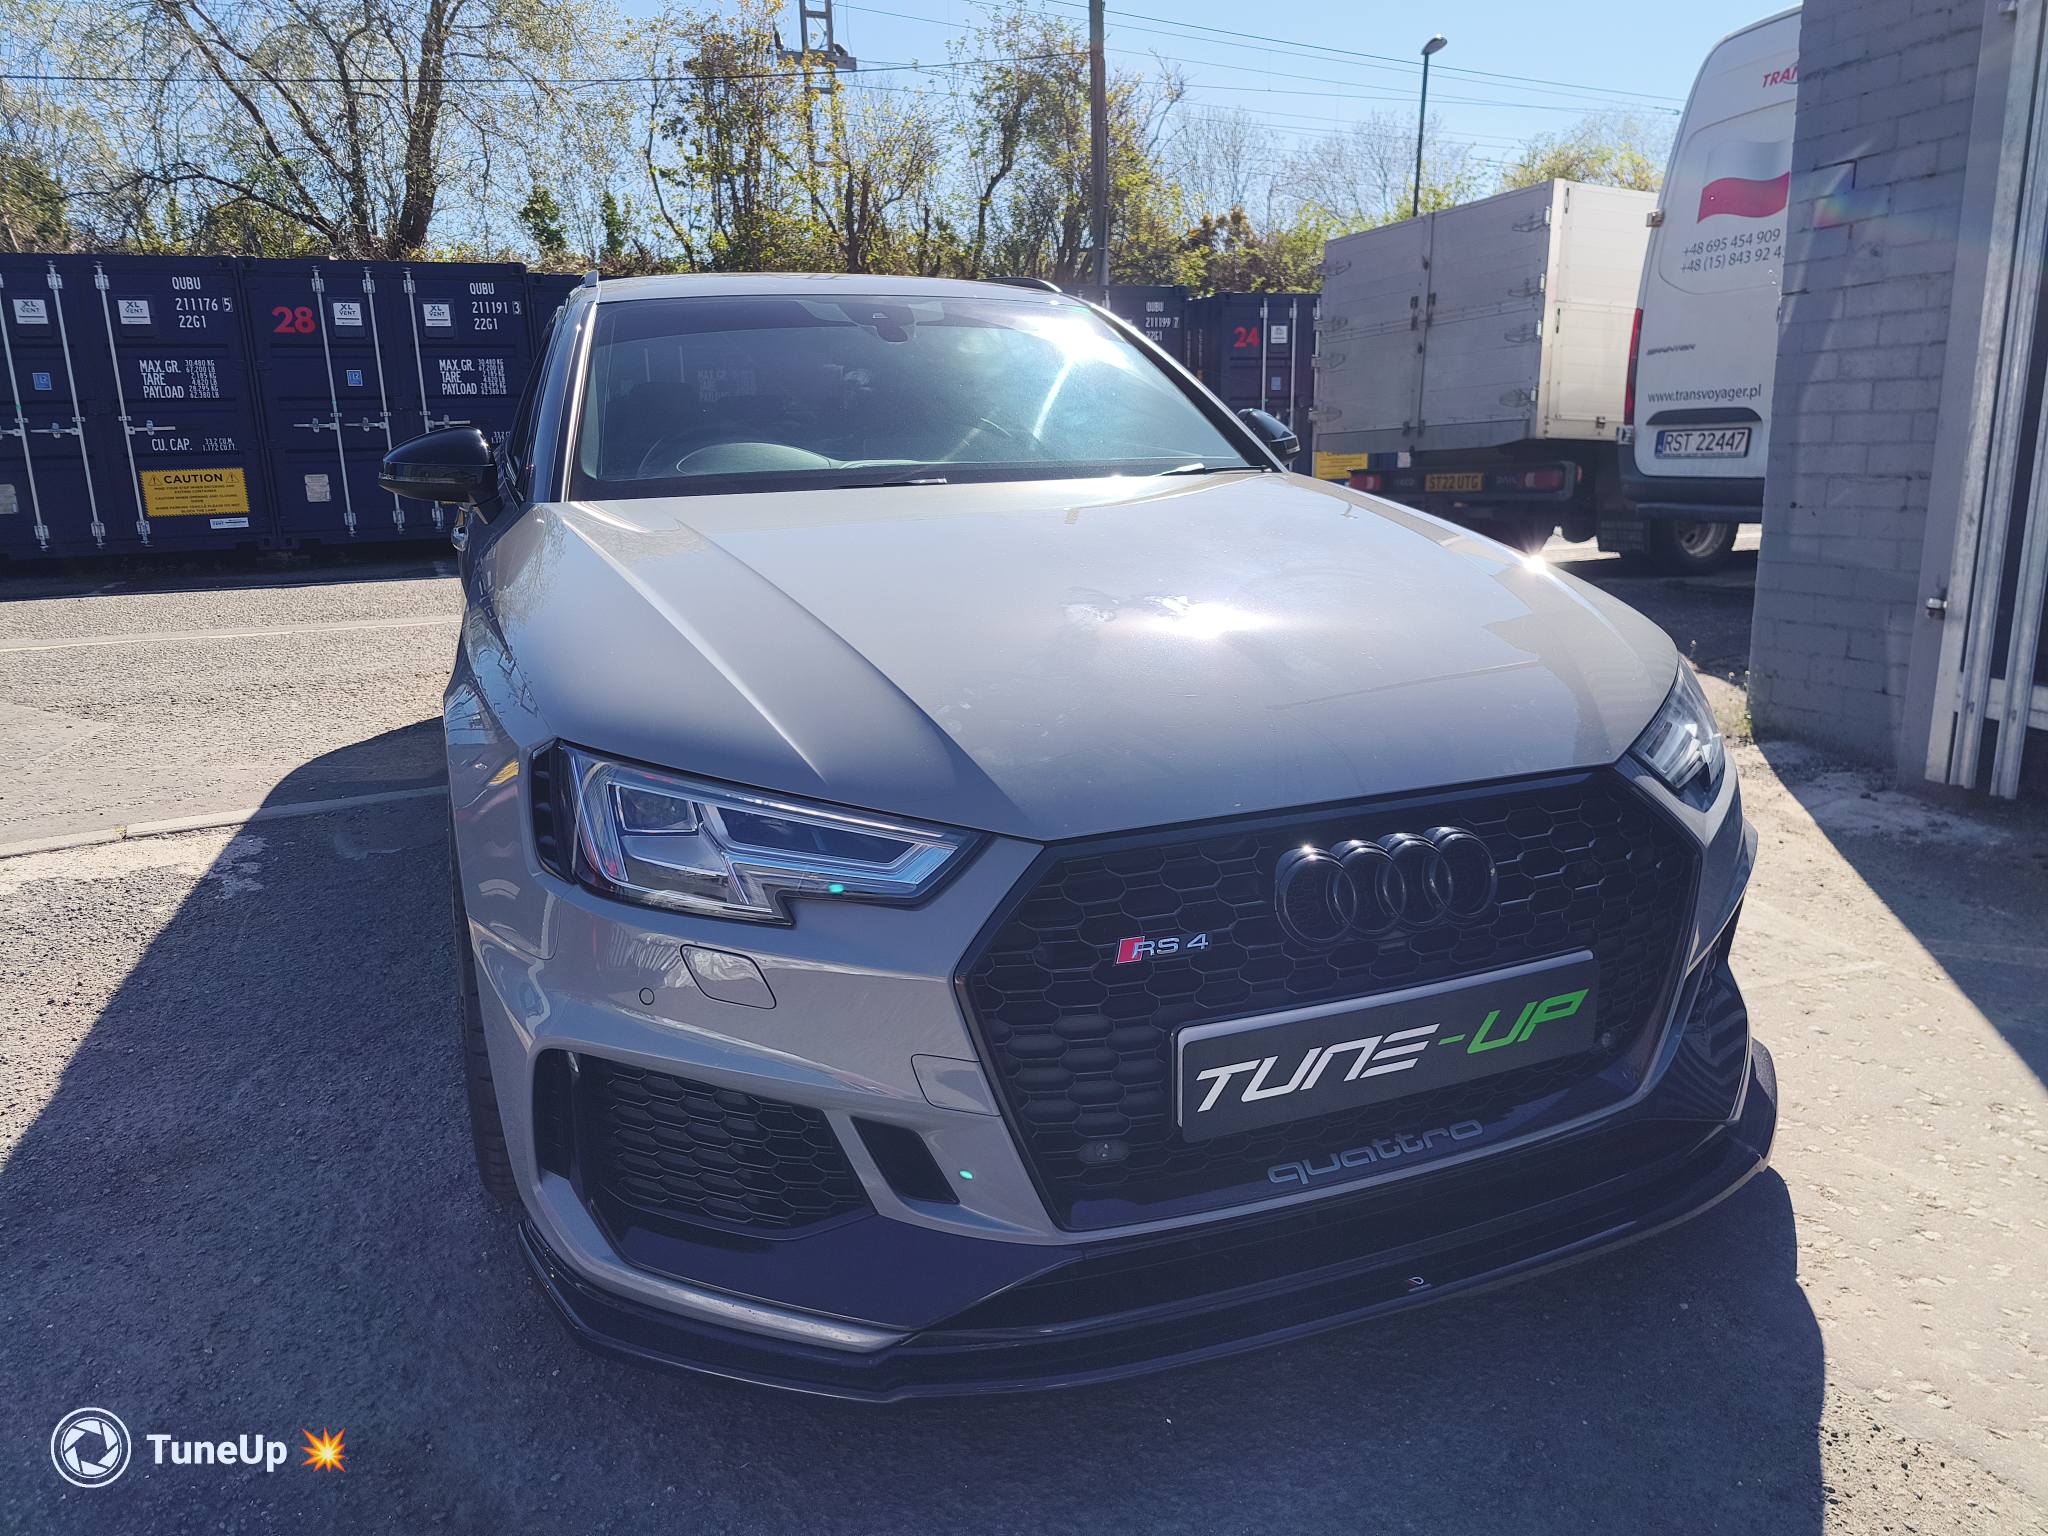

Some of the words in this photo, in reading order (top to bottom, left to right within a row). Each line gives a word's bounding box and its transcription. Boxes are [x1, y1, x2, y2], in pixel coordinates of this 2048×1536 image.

[1683, 242, 1704, 257] +48
[1706, 237, 1728, 254] 695
[1730, 232, 1753, 248] 454
[1756, 228, 1781, 244] 909
[1681, 258, 1701, 272] +48
[1704, 253, 1727, 272] (15)
[1728, 250, 1752, 266] 843
[1755, 247, 1771, 262] 92
[172, 277, 201, 290] QUBU
[469, 282, 495, 295] QUBU
[126, 301, 140, 309] XL
[175, 297, 219, 311] 211176
[223, 297, 232, 311] 5
[471, 301, 508, 314] 211191
[514, 301, 521, 314] 3
[178, 315, 207, 328] 22G1
[271, 305, 316, 334] 28
[473, 318, 498, 330] 22G1
[1233, 327, 1260, 348] 24
[139, 359, 182, 373] MAX.GR.
[438, 359, 475, 371] MAX.GR.
[141, 373, 167, 385] TARE
[440, 371, 463, 383] TARE
[143, 385, 185, 398] PAYLOAD
[441, 383, 478, 395] PAYLOAD
[1647, 384, 1762, 403] www.transvoyager.pl
[151, 438, 168, 451] CU.
[170, 438, 193, 451] CAP.
[1664, 434, 1693, 451] RST
[1695, 432, 1746, 451] 22447
[163, 473, 223, 484] CAUTION
[1131, 937, 1180, 959] RS
[1186, 933, 1209, 950] 4
[1196, 988, 1589, 1112] TUNE-UP
[1267, 1119, 1483, 1184] quattro
